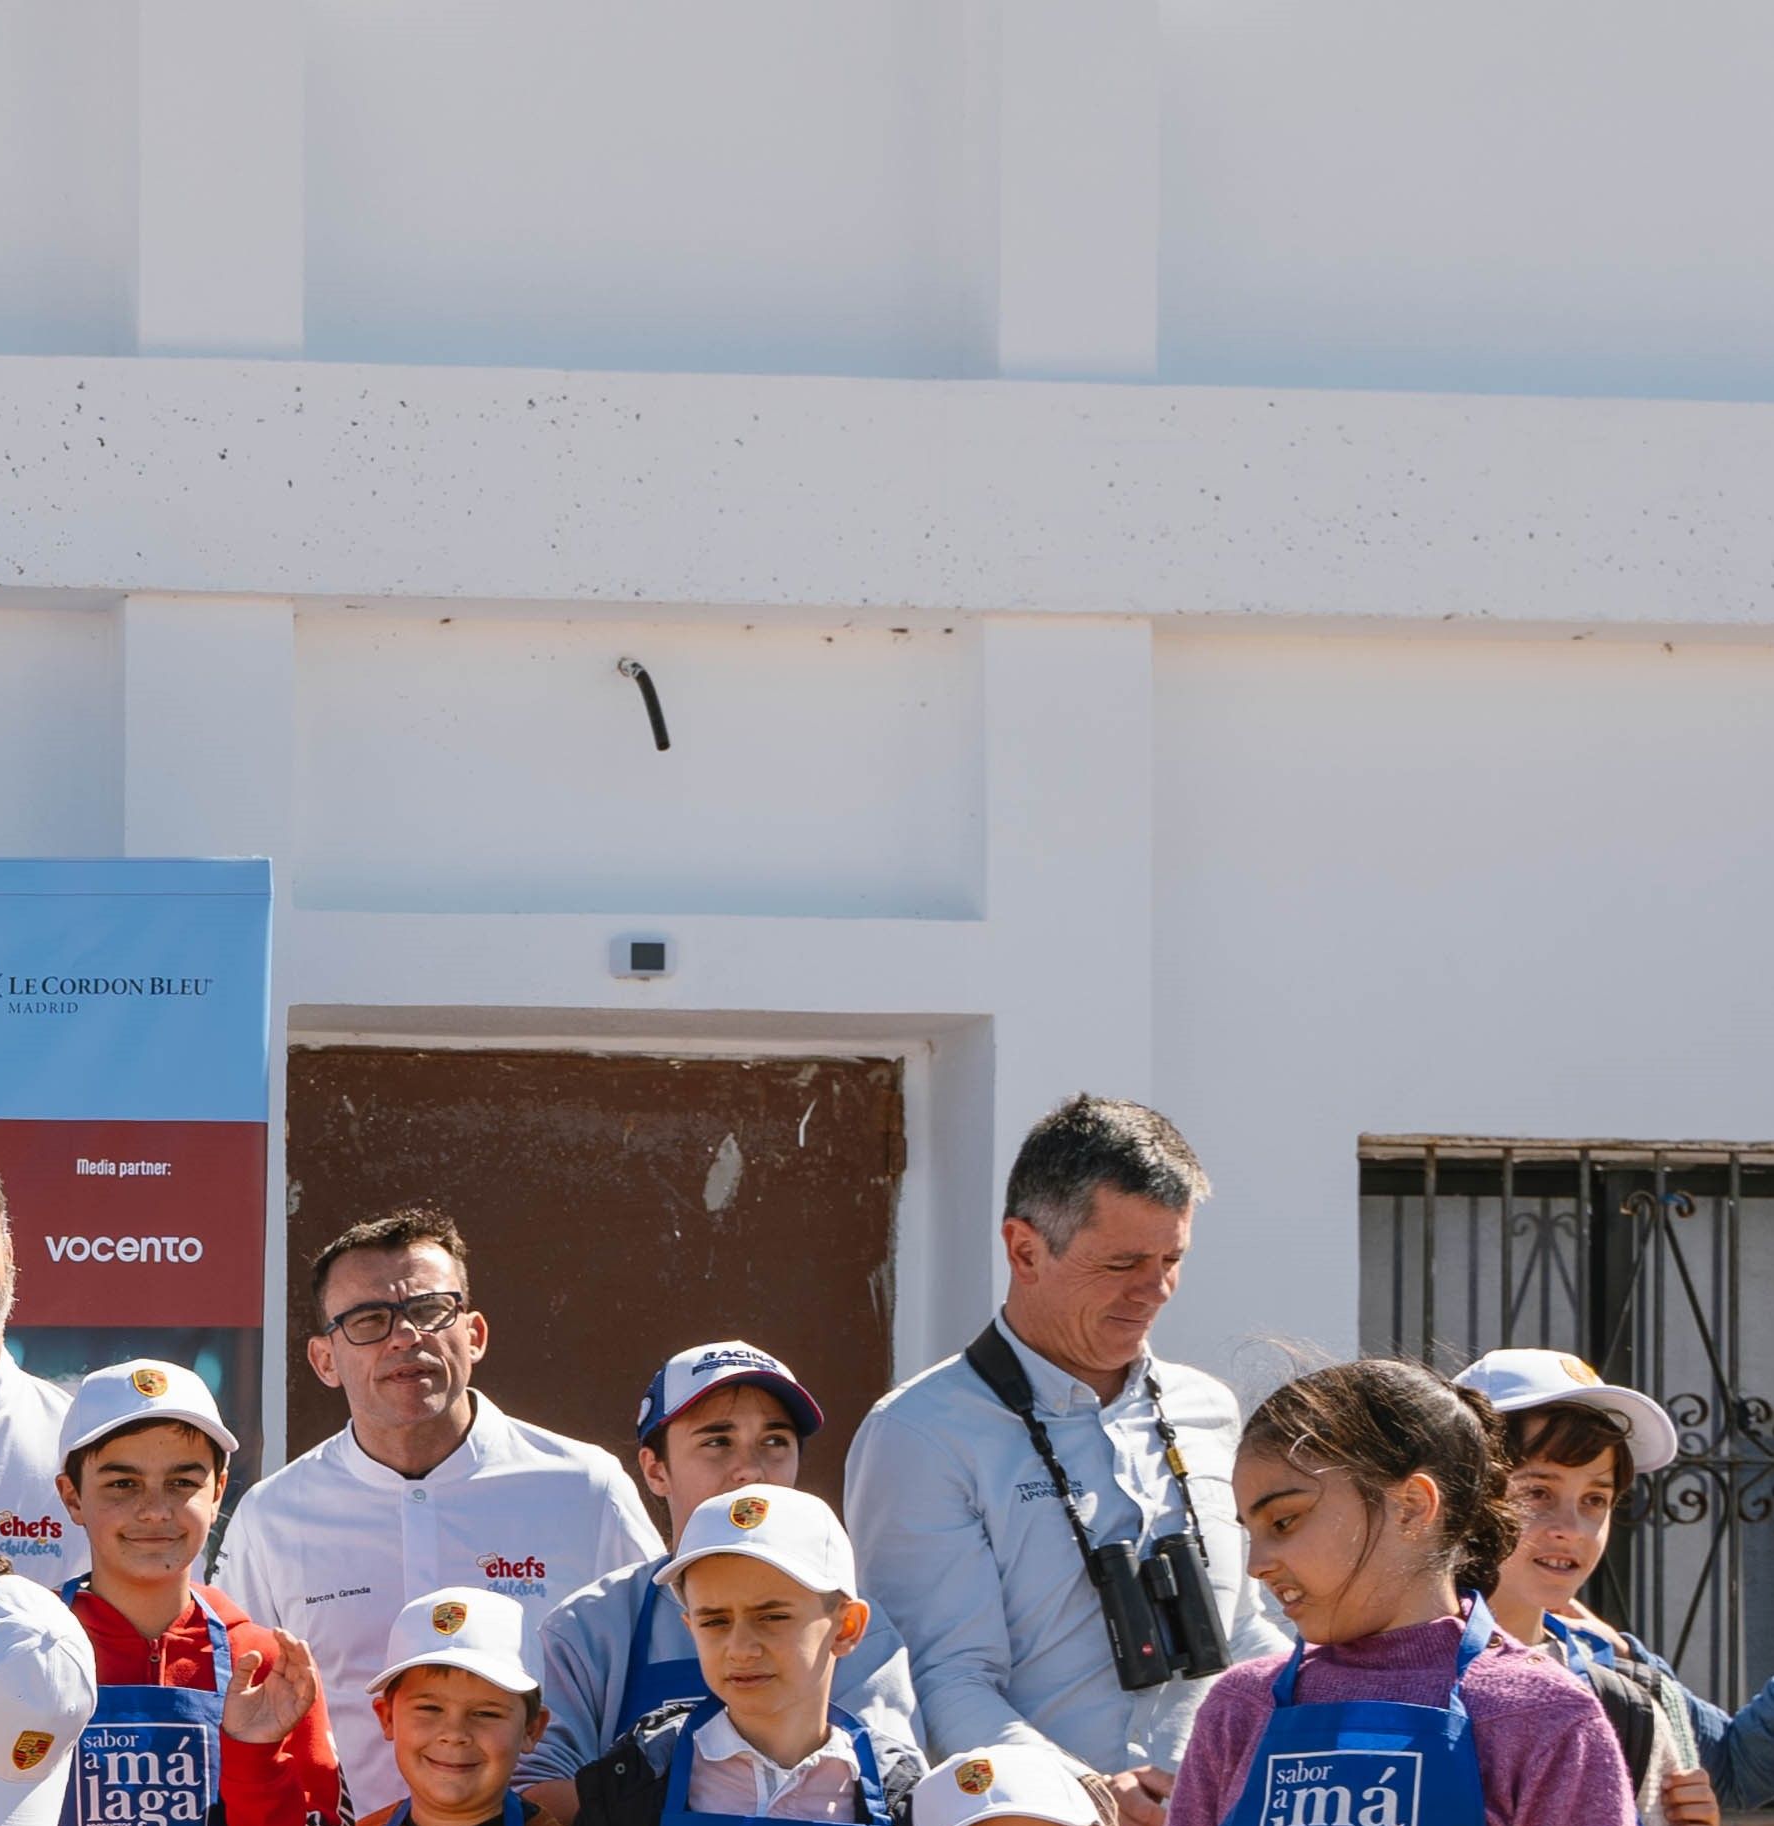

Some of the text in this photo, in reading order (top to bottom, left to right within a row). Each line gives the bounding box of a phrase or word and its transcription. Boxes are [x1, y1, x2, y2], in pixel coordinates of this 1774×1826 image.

[9, 977, 210, 996] LE CORDON BLEU
[8, 1002, 78, 1014] MADRID
[76, 1158, 171, 1177] Media partner:
[45, 1236, 203, 1262] vocento
[1, 1516, 62, 1538] chefs
[486, 1556, 545, 1579] chefs
[83, 1729, 139, 1749] sabor
[84, 1736, 202, 1786] a má
[1276, 1761, 1333, 1785] sabor
[1273, 1788, 1288, 1809] a
